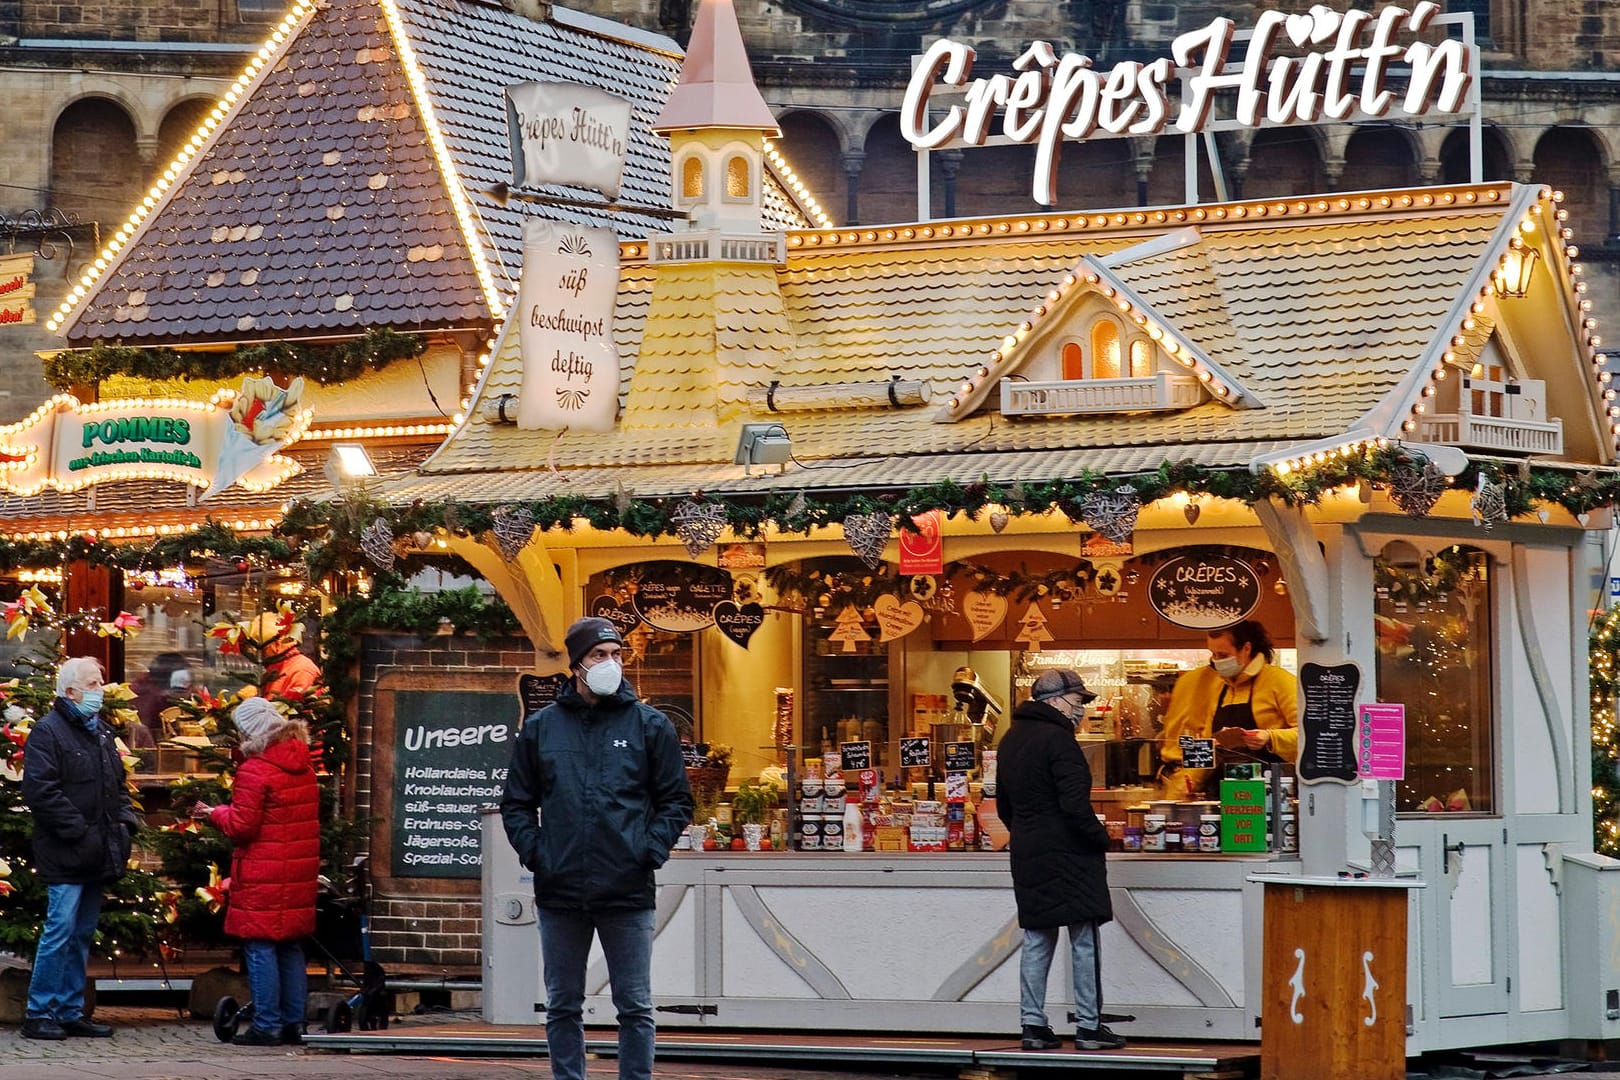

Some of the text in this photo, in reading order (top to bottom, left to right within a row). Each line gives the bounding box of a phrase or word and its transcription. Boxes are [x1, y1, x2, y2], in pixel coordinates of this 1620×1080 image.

[900, 1, 1473, 206] Crêpes Hütt'n
[559, 267, 587, 298] süß
[531, 304, 603, 342] beschwipst
[551, 350, 593, 383] deftig
[82, 416, 191, 448] POMMES
[91, 448, 140, 467] frischen
[140, 448, 201, 469] Kartoffeln
[1176, 562, 1237, 582] CRÊPES
[598, 607, 636, 624] CRÊPES
[719, 612, 762, 624] CRÊPES
[404, 724, 508, 751] Unsere
[404, 783, 504, 798] Knoblauchsoß
